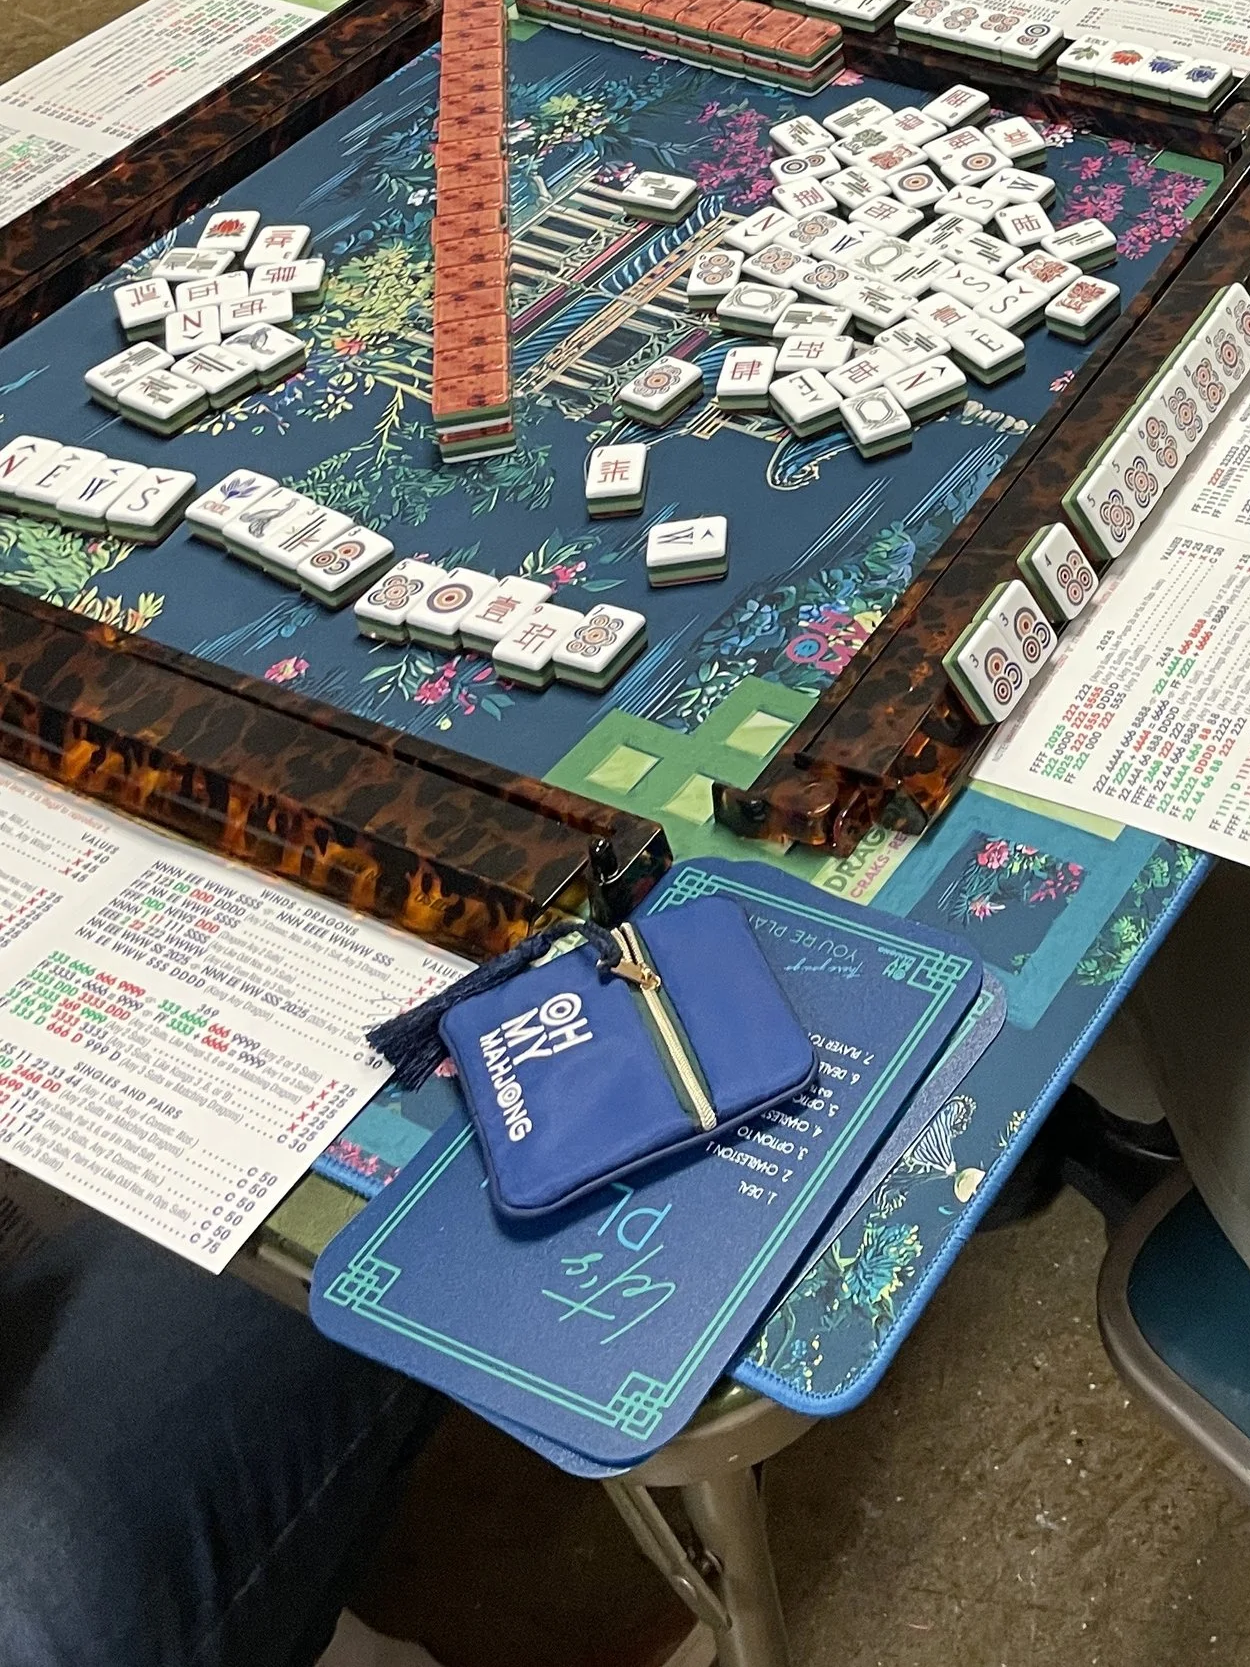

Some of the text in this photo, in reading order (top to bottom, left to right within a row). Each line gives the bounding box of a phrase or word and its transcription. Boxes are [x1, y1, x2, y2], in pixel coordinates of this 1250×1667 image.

[0, 455, 159, 512] N E W S
[656, 527, 694, 545] W
[1096, 630, 1115, 650] 2025
[1155, 646, 1174, 667] 2468
[1029, 683, 1092, 773] FFFF 2025 222 222
[1040, 686, 1103, 776] 222 0000 222 5555
[1052, 682, 1118, 779] 2025 222 555 DDDD
[1063, 692, 1126, 783] FF 222 000 222 555
[1168, 717, 1232, 817] FF 2222 DDDD 2222
[1181, 717, 1247, 821] 22 44 66 88 222 222
[823, 826, 887, 892] DRAG
[850, 833, 908, 898] CRAKS RE
[140, 896, 219, 933] DDD NEWS DDD
[151, 860, 185, 878] NNNN
[183, 872, 204, 885] EEE
[203, 880, 237, 898] WWW
[235, 893, 263, 909] SSSS
[275, 910, 304, 927] NNN
[328, 932, 373, 956] WWWW
[371, 952, 394, 966] SSS
[260, 889, 358, 935] WINDS DRAGONS
[789, 926, 858, 963] YOU'RE
[111, 941, 205, 987] WWW SSS DDDD
[58, 997, 81, 1011] 369
[79, 1007, 107, 1024] 9999
[196, 1003, 219, 1018] 369
[541, 992, 594, 1056] OH
[46, 1021, 121, 1060] 666 D 999 D
[501, 1008, 554, 1068] MY
[809, 1033, 874, 1065] 7. PLAYER TO
[11, 1064, 61, 1092] 2468 DD
[365, 1056, 382, 1068] 30
[849, 1072, 860, 1085] 6.
[73, 1061, 182, 1119] SINGLES AND PAIRS
[479, 1033, 533, 1142] MAHJONG
[760, 1106, 823, 1138] 4. CHARLEST
[827, 1103, 839, 1117] 5.
[714, 1143, 780, 1177] CHARLESTON
[736, 1124, 808, 1160] 3. OPTION TO
[737, 1180, 777, 1205] 1. DEAL
[780, 1168, 792, 1183] 2.
